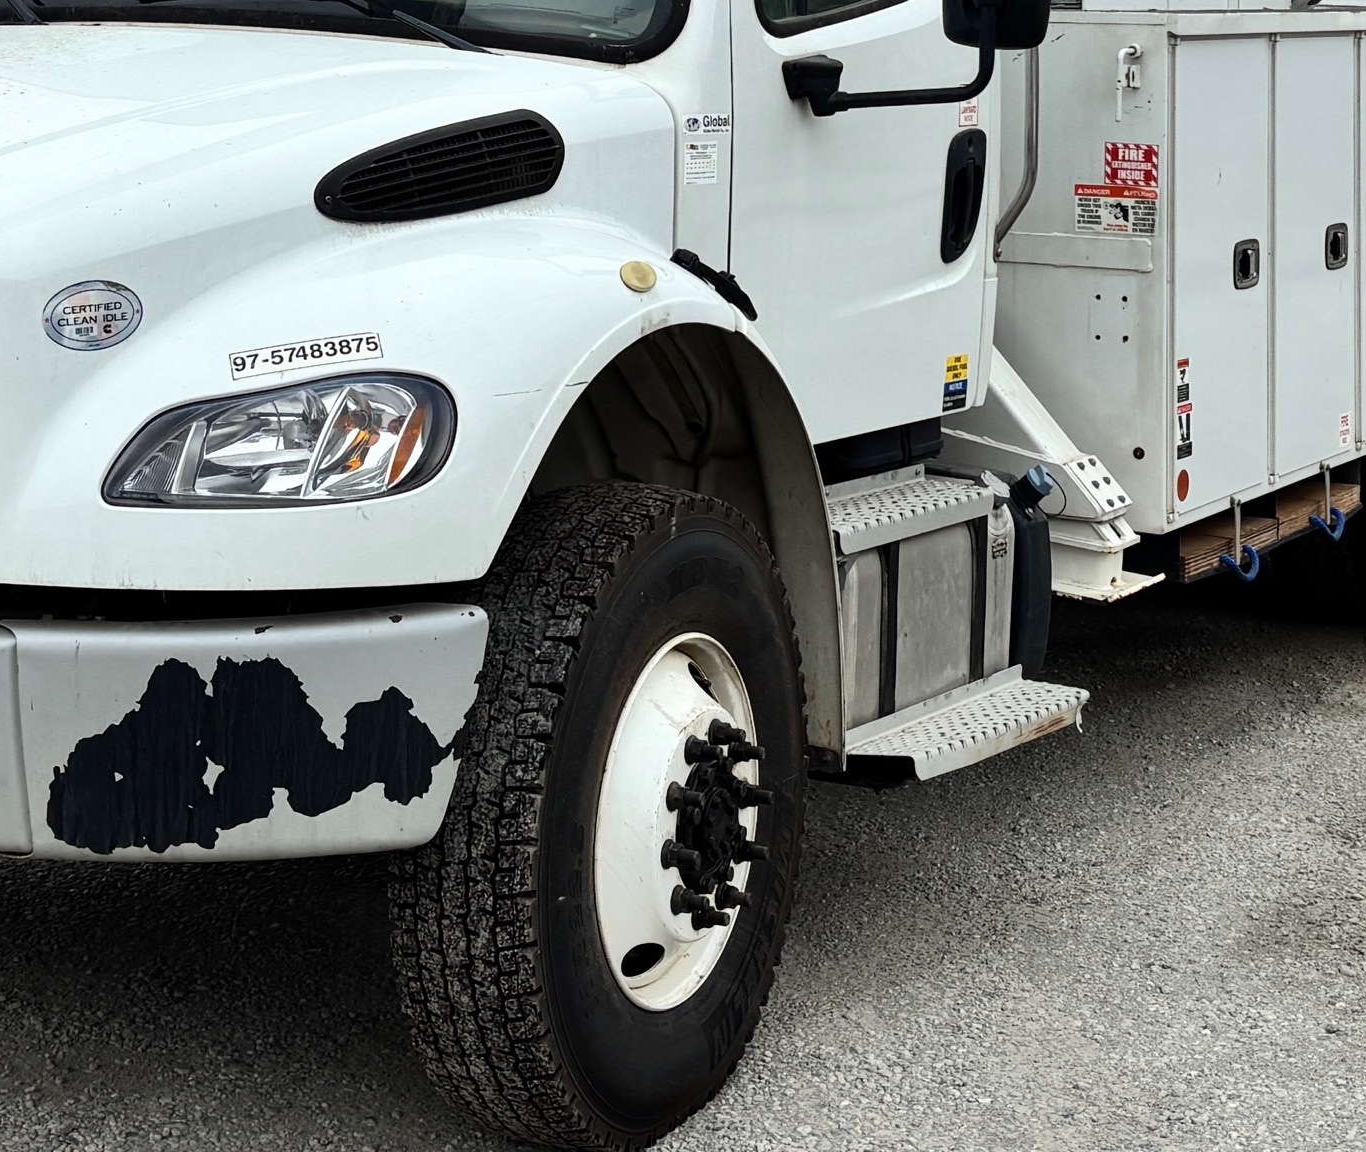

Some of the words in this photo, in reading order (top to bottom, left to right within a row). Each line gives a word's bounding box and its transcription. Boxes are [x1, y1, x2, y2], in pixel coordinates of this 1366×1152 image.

[702, 115, 731, 128] Global
[1118, 148, 1145, 162] FIRE
[1117, 170, 1145, 181] INSIDE
[1083, 188, 1111, 196] DANGER
[62, 301, 123, 315] CERTIFIED
[57, 315, 98, 327] CLEAN
[102, 312, 130, 323] IDLE
[232, 336, 380, 372] 97-57483875
